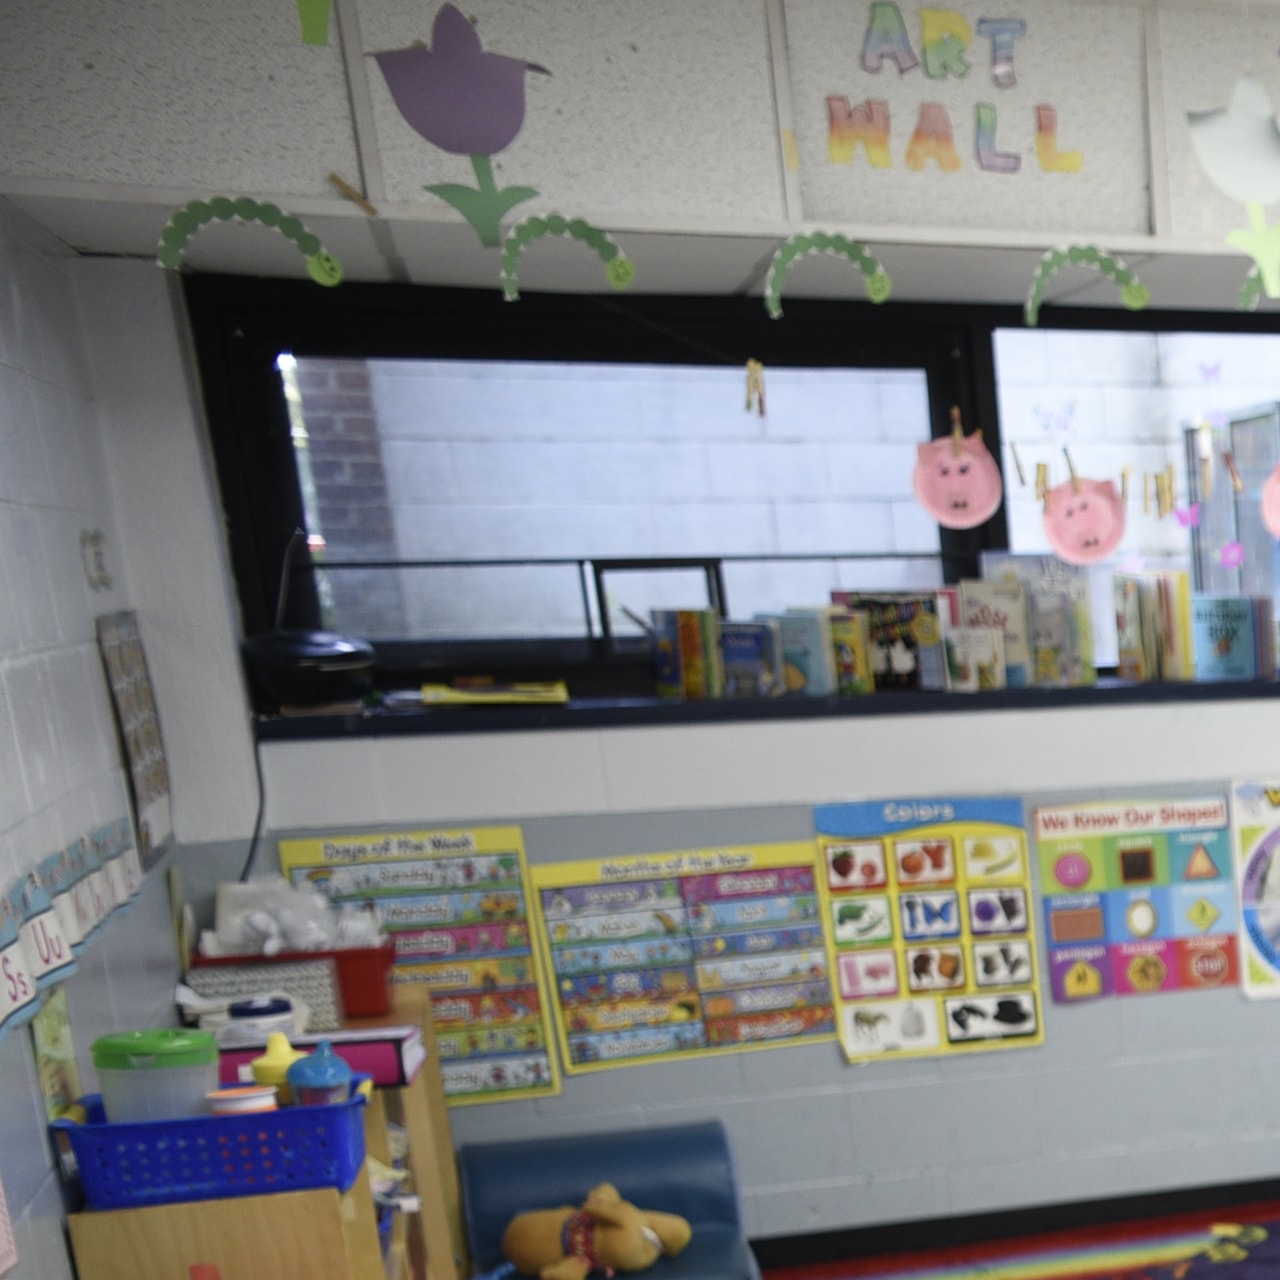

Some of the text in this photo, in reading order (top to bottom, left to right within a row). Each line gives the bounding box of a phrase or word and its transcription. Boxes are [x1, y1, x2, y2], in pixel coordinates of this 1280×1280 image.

[862, 1, 1027, 89] ART
[826, 95, 1084, 174] WALL
[884, 803, 955, 822] Colors
[1041, 804, 1223, 830] We Know Our Shapes!
[323, 840, 367, 860] Days
[372, 840, 391, 853] of
[432, 834, 472, 851] Week
[32, 920, 62, 964] Uu
[2, 956, 28, 1002] Ss
[1196, 959, 1225, 974] STOP
